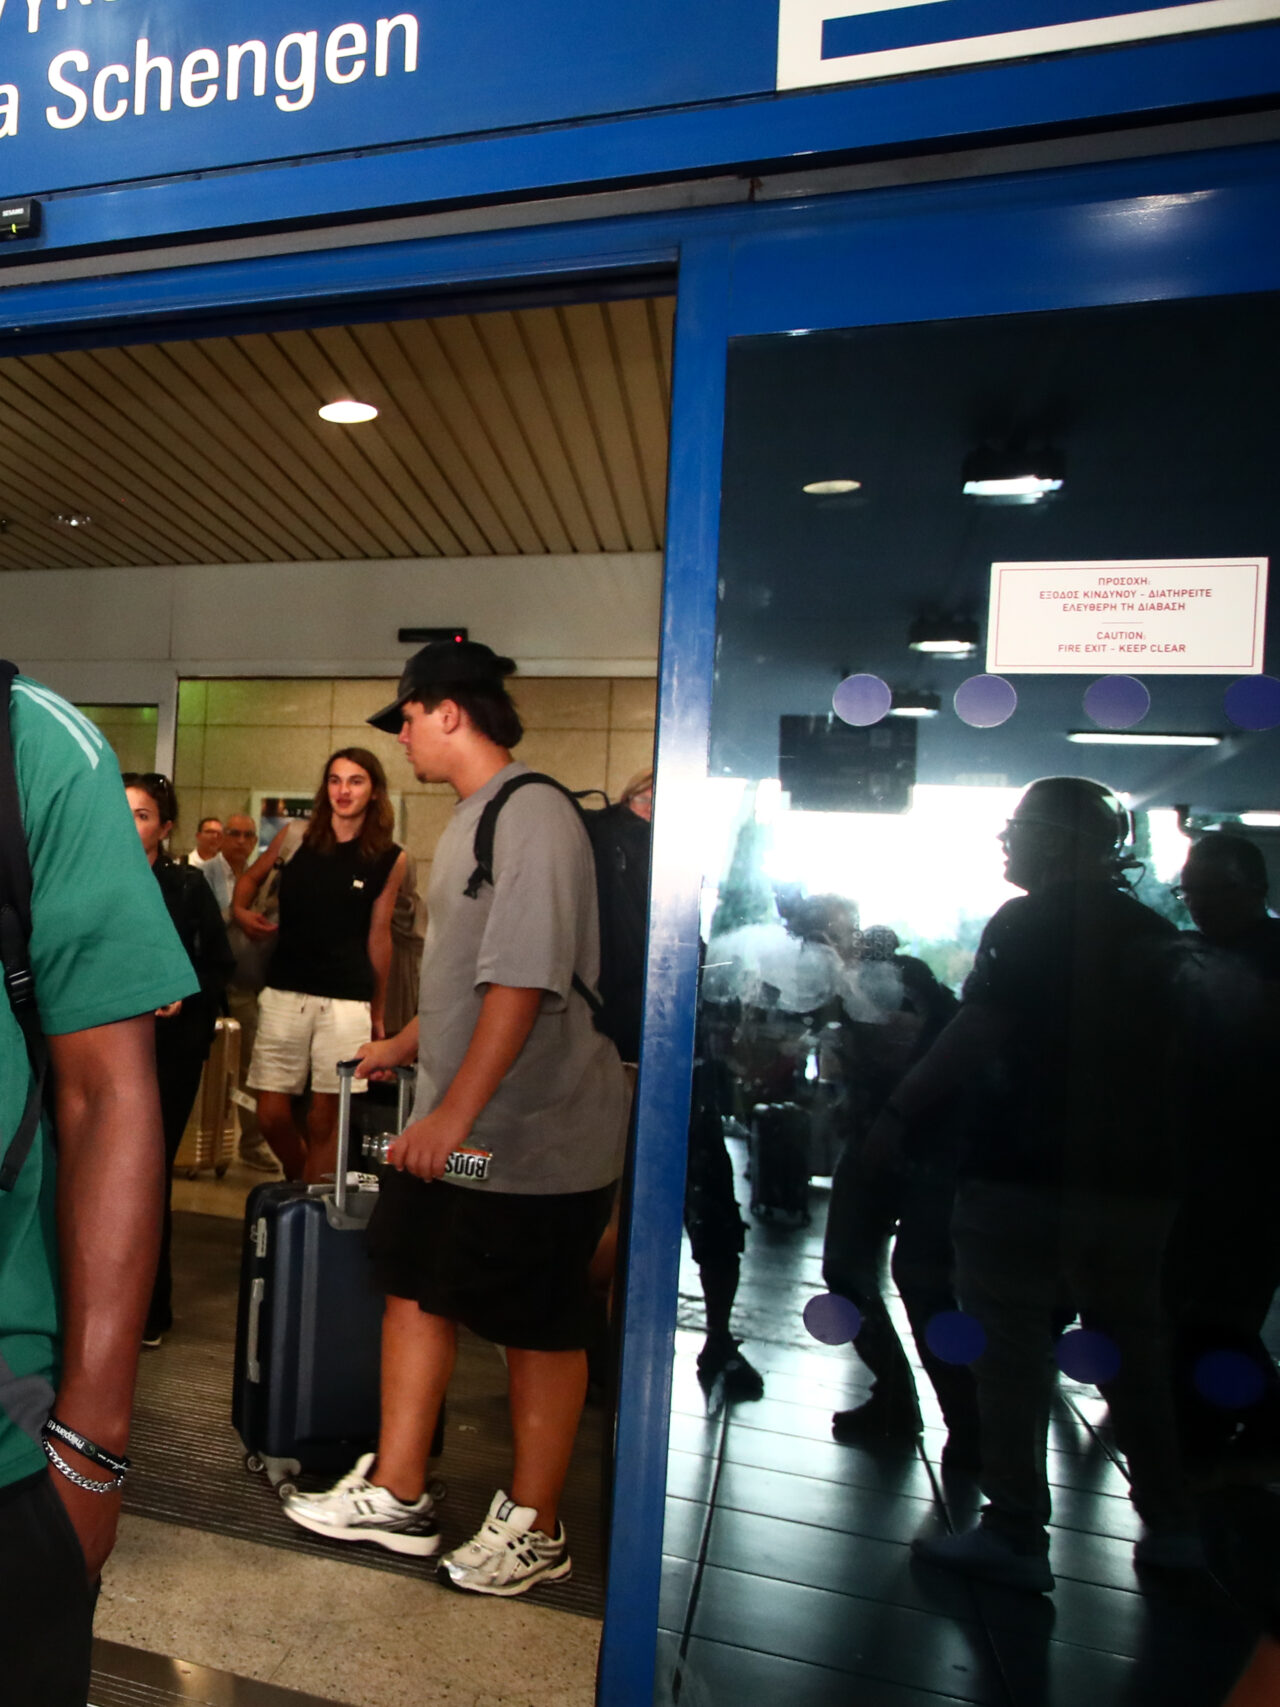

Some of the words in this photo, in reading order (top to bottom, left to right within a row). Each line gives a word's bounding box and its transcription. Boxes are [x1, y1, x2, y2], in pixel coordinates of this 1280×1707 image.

[45, 13, 419, 130] Schengen
[1039, 590, 1079, 600] ΕΞΟΔΟΣ
[1082, 590, 1137, 599] ΚΙΝΔΥΝΟΥ
[1148, 588, 1212, 599] ΔΙΑΤΗΡΕΙΤΕ
[1062, 603, 1117, 612] ΕΛΕΥΘΕΡΗ
[1121, 602, 1135, 611] ΤΗ
[1138, 602, 1186, 611] ΔΙΑΒΑΣΗ
[1057, 644, 1081, 653] FIRE
[1084, 644, 1107, 653] EXIT
[1118, 644, 1147, 653] KEEP
[1150, 644, 1186, 653] CLEAR
